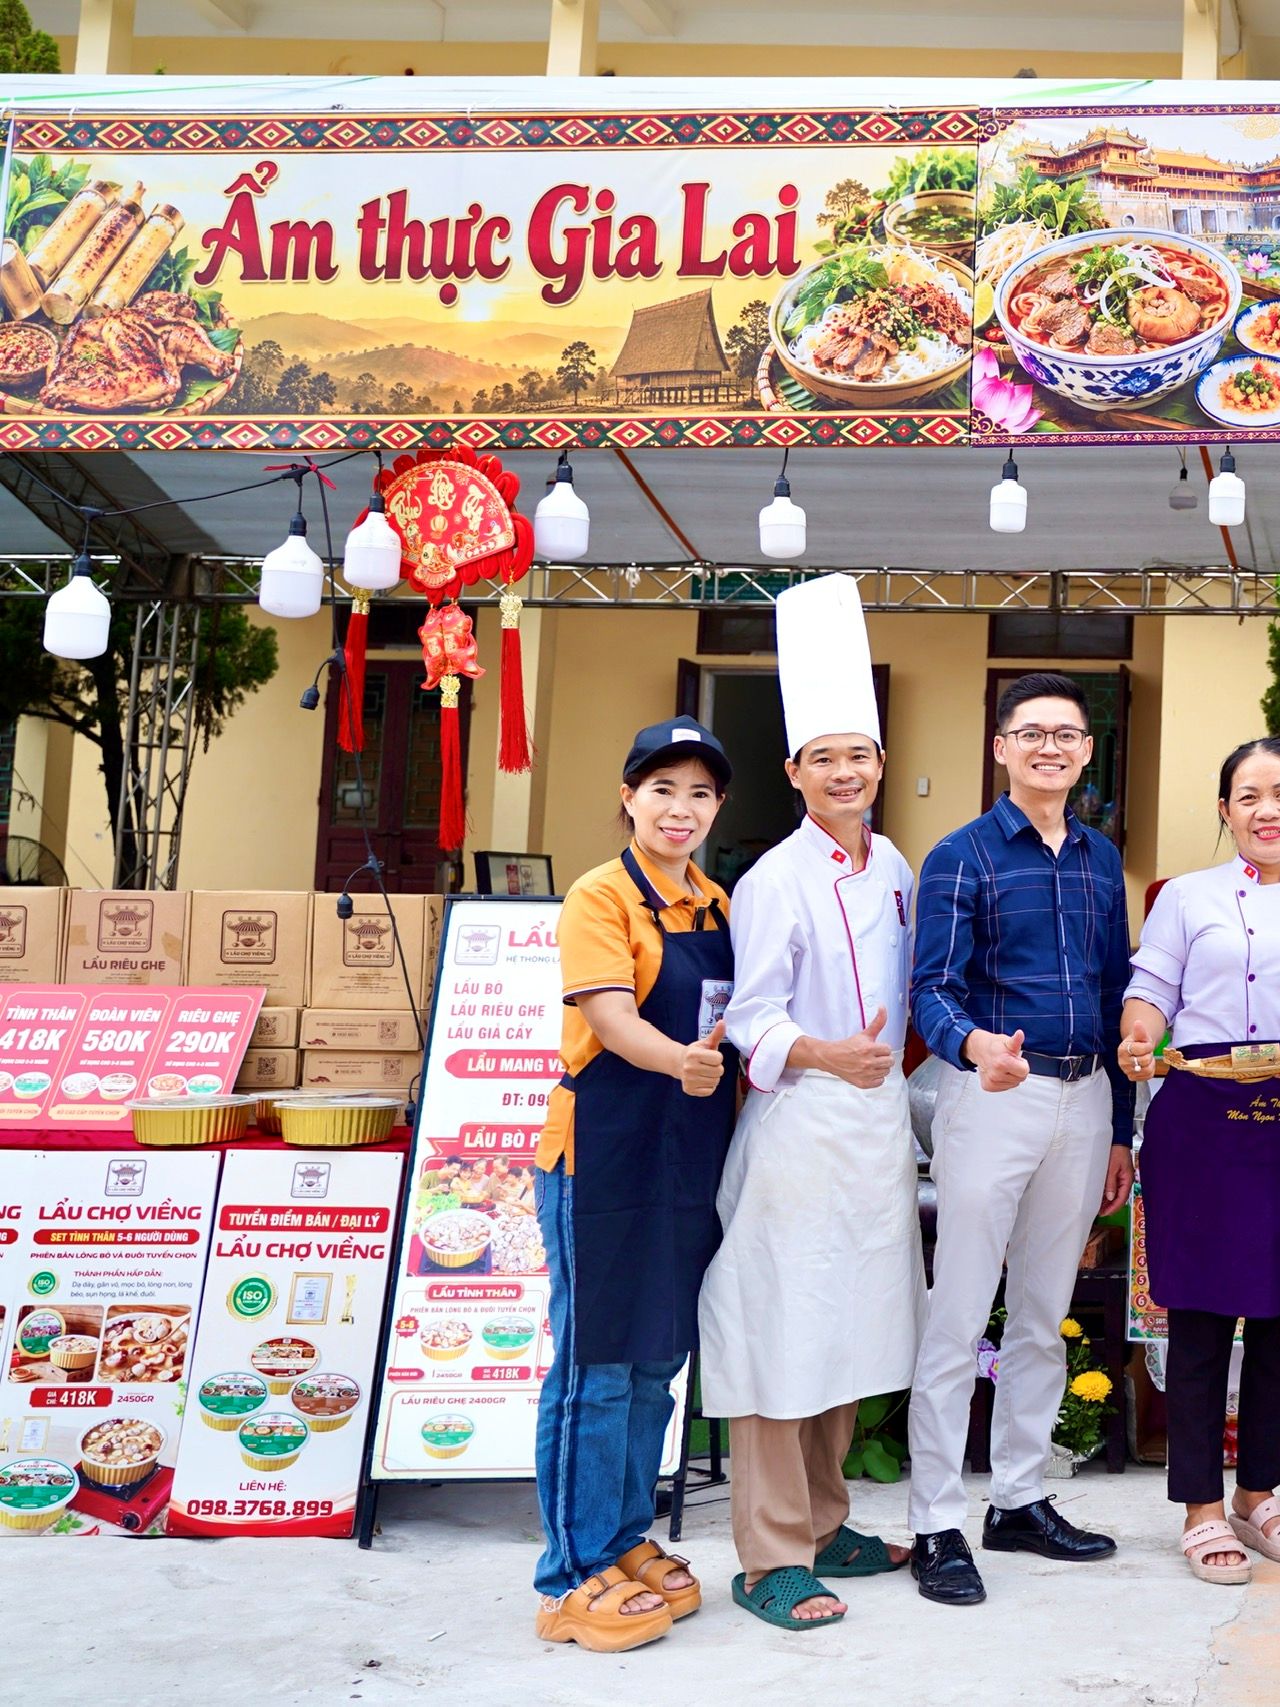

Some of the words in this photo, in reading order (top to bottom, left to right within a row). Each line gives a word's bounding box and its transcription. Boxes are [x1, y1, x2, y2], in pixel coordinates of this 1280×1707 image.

[194, 160, 338, 287] Ẩm
[357, 187, 512, 308] thực
[526, 182, 663, 304] Gia
[676, 182, 801, 279] Lai
[83, 955, 107, 970] LẨU
[110, 958, 138, 970] RIÊU
[141, 960, 166, 972] GHẸ
[454, 977, 479, 995] LẨU
[484, 980, 503, 995] BÒ
[6, 1005, 38, 1020] TÌNH
[40, 1006, 77, 1020] THÂN
[89, 1007, 128, 1022] ĐOÀN
[130, 1007, 162, 1023] VIÊN
[177, 1008, 210, 1023] RIÊU
[212, 1011, 242, 1027] GHẸ
[451, 999, 476, 1016] LẨU
[481, 1002, 513, 1016] RIÊU
[518, 1005, 545, 1020] GHẸ
[447, 1020, 473, 1039] LẨU
[0, 1028, 67, 1051] 418K
[82, 1029, 152, 1052] 580K
[165, 1031, 236, 1053] 290K
[467, 1052, 496, 1072] LẨU
[500, 1058, 544, 1072] MANG
[502, 1093, 524, 1106] ĐT:
[1252, 1111, 1275, 1123] Ngon
[464, 1126, 497, 1148] LẨU
[501, 1129, 525, 1148] BÒ
[39, 1198, 82, 1220] LẨU
[87, 1204, 132, 1223] CHỢ
[136, 1198, 202, 1220] VIỀNG
[229, 1208, 267, 1225] TUYỂN
[270, 1209, 301, 1226] ĐIỂM
[305, 1212, 330, 1227] BÁN
[340, 1215, 361, 1229] ĐẠI
[364, 1212, 380, 1227] LÝ
[50, 1232, 66, 1242] SET
[69, 1230, 91, 1242] TÌNH
[93, 1231, 115, 1242] THÂN
[117, 1233, 132, 1242] 5-6
[134, 1230, 162, 1242] NGƯỜI
[164, 1230, 189, 1242] DÙNG
[30, 1251, 55, 1259] PHIÊN
[56, 1251, 74, 1259] BẢN
[76, 1251, 98, 1259] LÒNG
[99, 1251, 111, 1259] BÒ
[112, 1251, 123, 1259] VÀ
[124, 1251, 145, 1259] ĐUÔI
[146, 1250, 173, 1259] TUYỂN
[174, 1252, 197, 1260] CHỌN
[216, 1234, 261, 1257] LẨU
[265, 1241, 312, 1261] CHỢ
[316, 1235, 385, 1259] VIỀNG
[74, 1269, 101, 1277] THÀNH
[243, 1291, 262, 1300] ISO
[432, 1285, 455, 1297] LẨU
[457, 1286, 485, 1297] TÌNH
[487, 1286, 517, 1298] THÂN
[492, 1368, 520, 1379] 418K
[59, 1390, 97, 1405] 418K
[117, 1395, 154, 1403] 2450GR
[401, 1395, 421, 1405] LẨU
[423, 1396, 446, 1405] RIÊU
[448, 1398, 466, 1406] GHẸ
[469, 1397, 506, 1405] 2400GR
[239, 1480, 266, 1491] LIÊN
[268, 1480, 287, 1491] HỆ:
[187, 1500, 333, 1516] 098.3768.899
